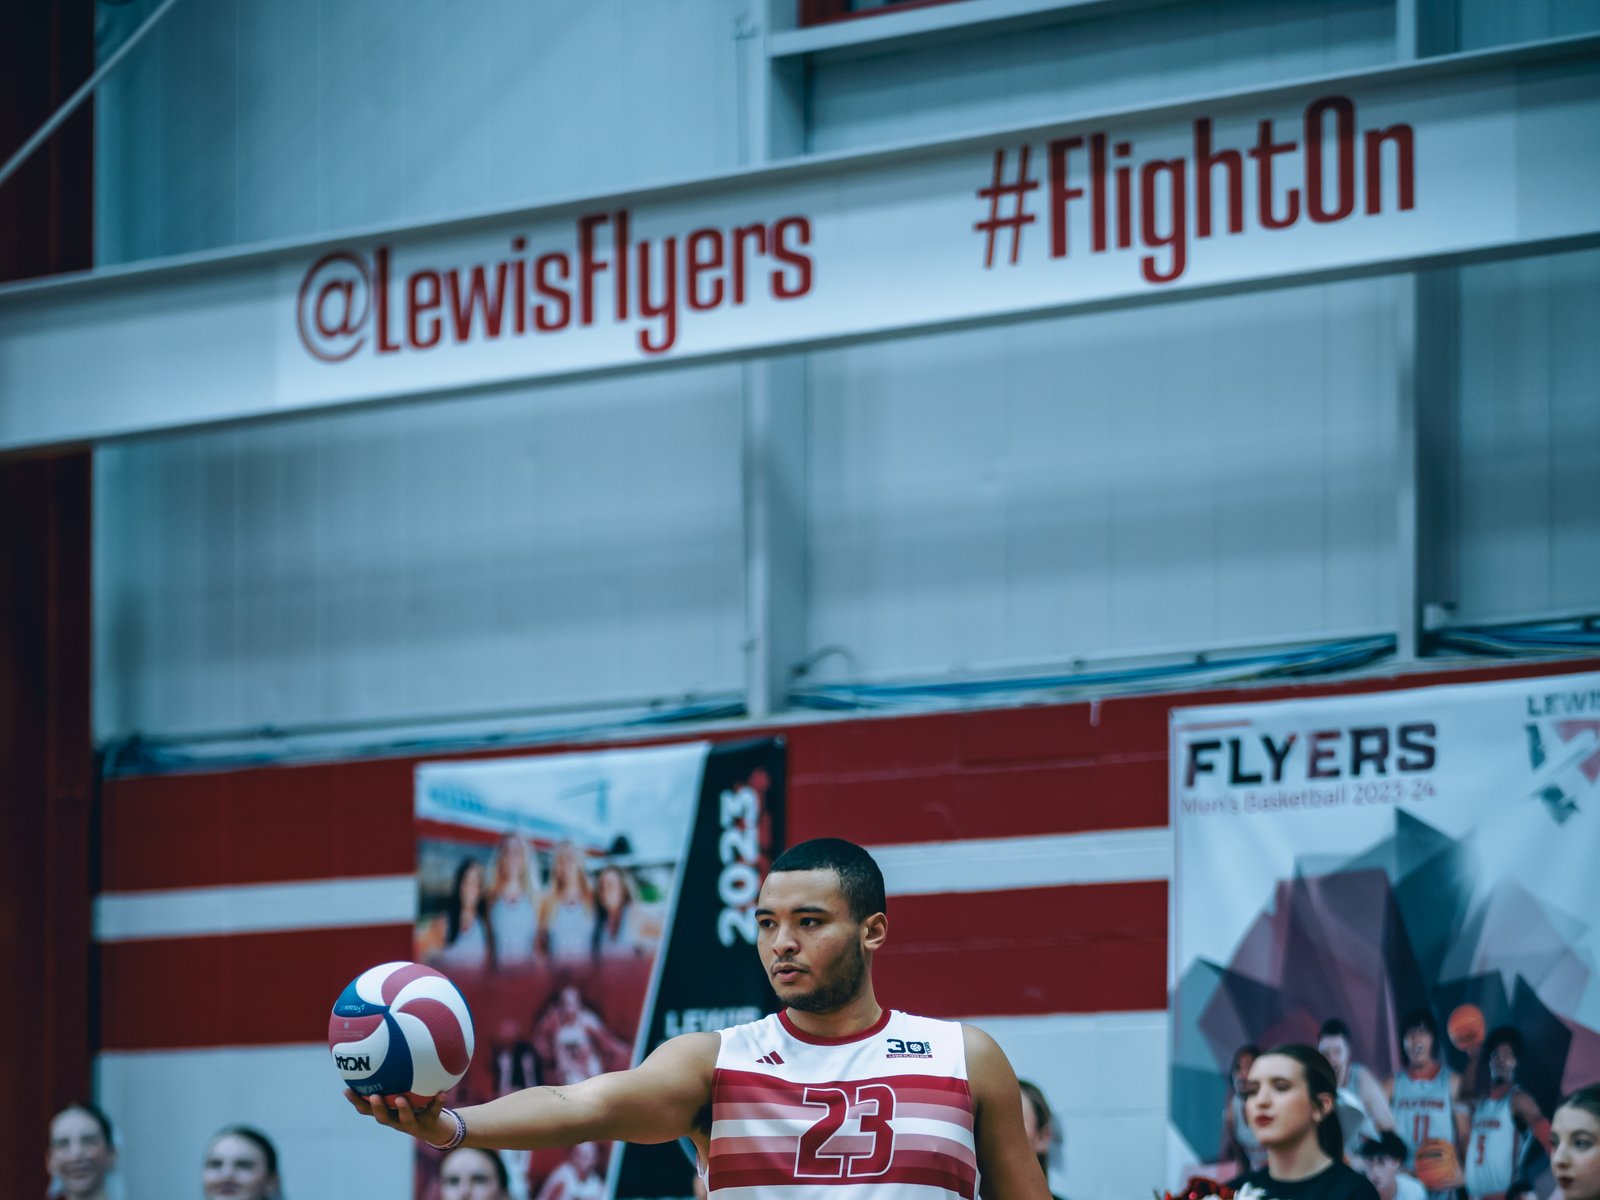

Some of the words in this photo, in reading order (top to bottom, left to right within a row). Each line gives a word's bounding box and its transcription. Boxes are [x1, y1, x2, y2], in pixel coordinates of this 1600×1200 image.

[974, 96, 1415, 284] #FlightOn
[297, 210, 813, 363] @LewisFlyers
[1526, 689, 1600, 716] LEWI
[1184, 723, 1437, 789] FLYERS
[1243, 784, 1346, 814] Basketball
[718, 785, 760, 947] 2023
[793, 1083, 897, 1178] 23
